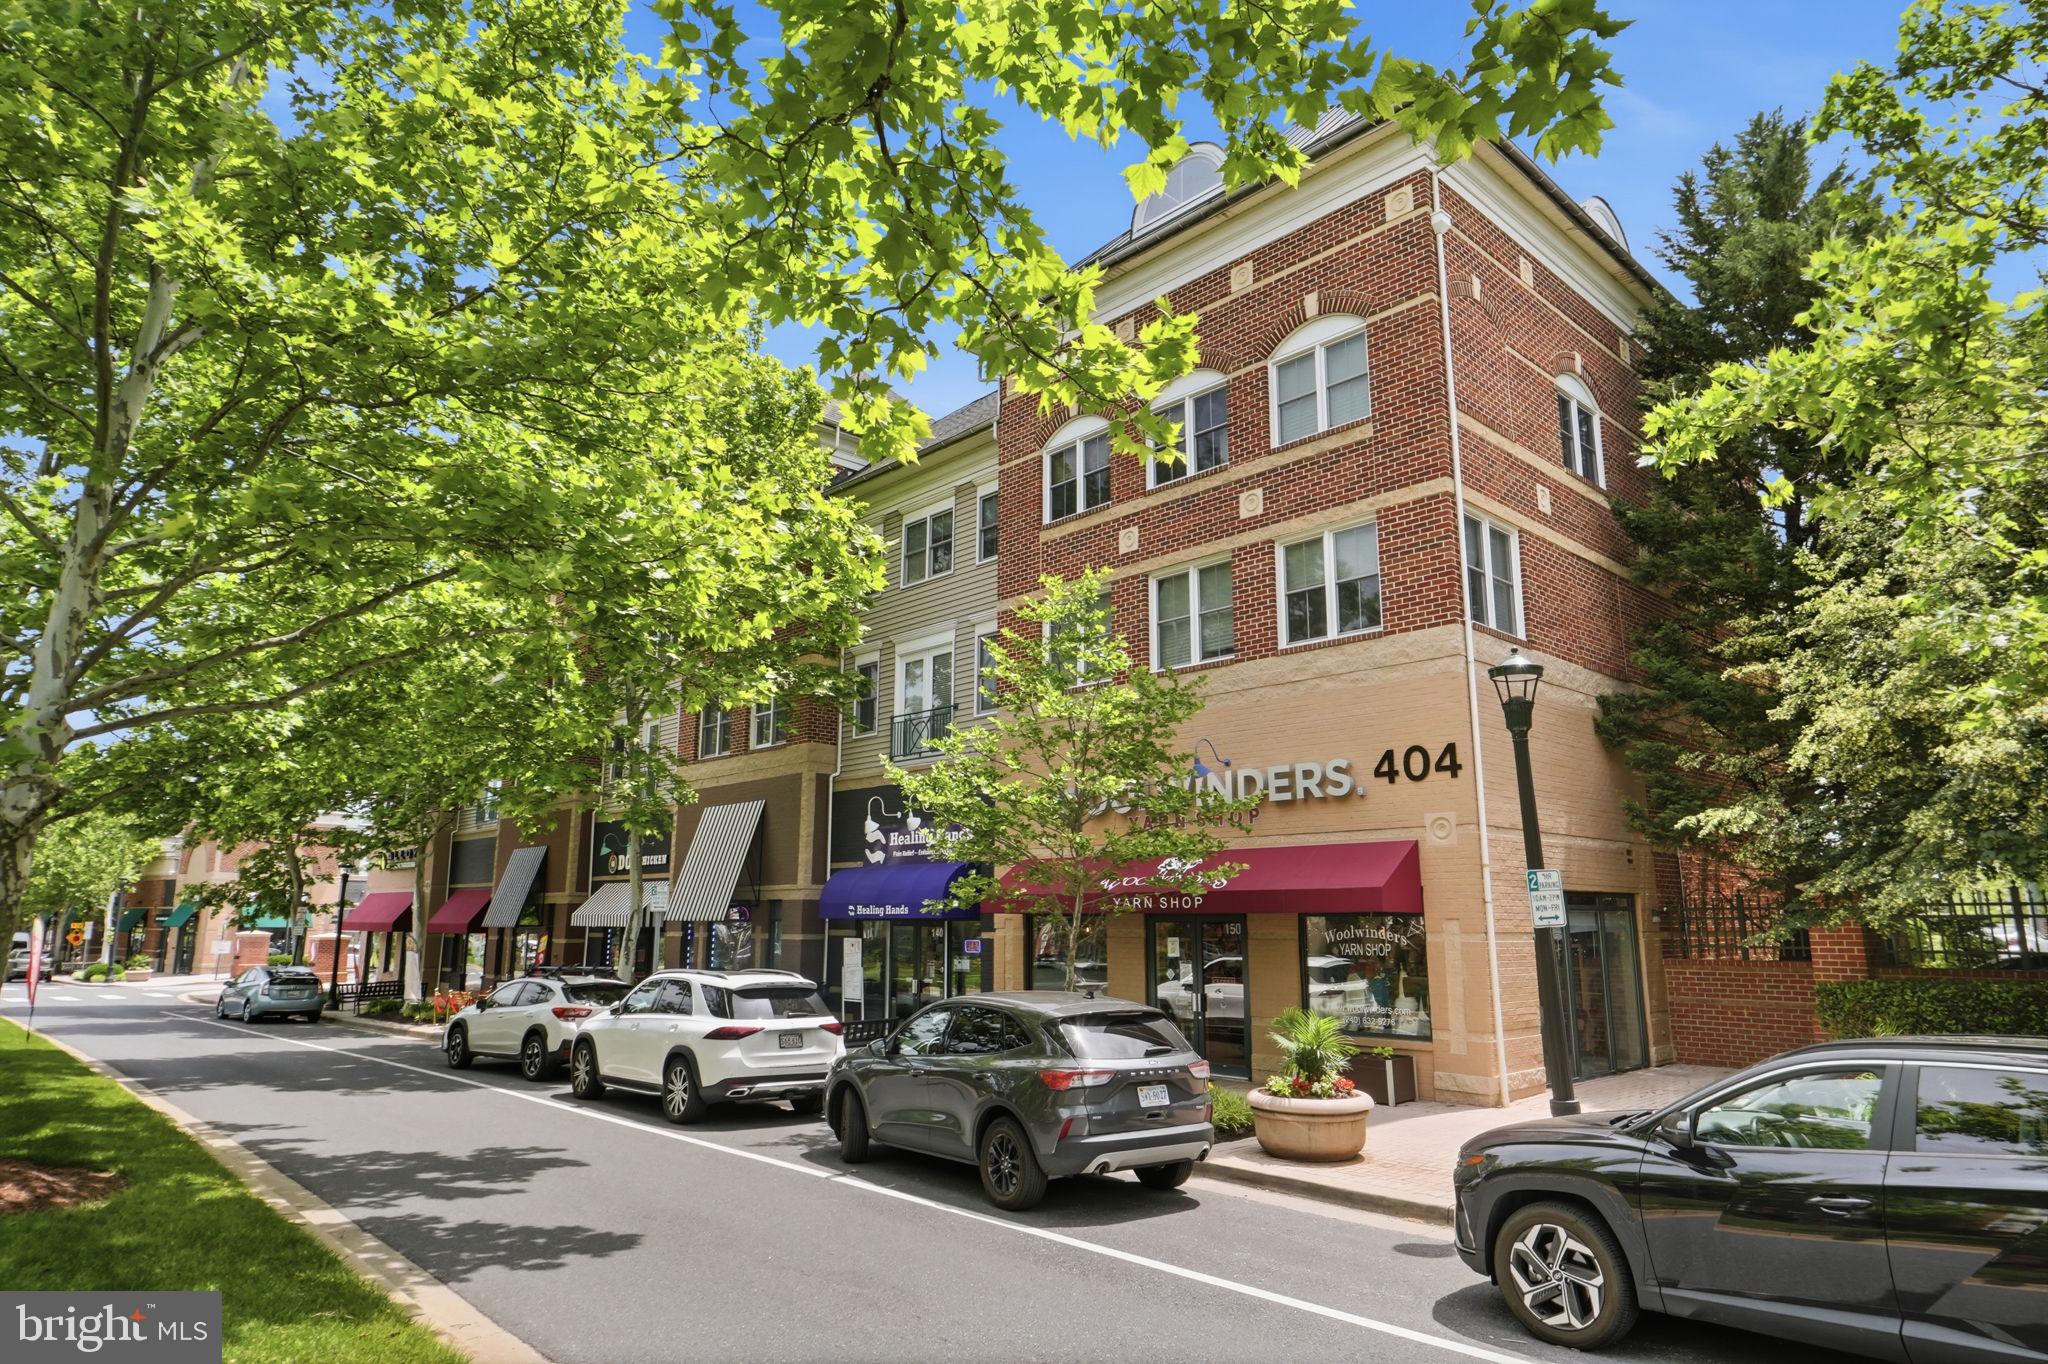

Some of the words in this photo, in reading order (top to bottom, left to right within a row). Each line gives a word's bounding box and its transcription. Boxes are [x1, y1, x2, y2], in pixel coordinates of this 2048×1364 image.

[1373, 742, 1462, 784] 404
[1529, 874, 1537, 889] 2
[1113, 897, 1152, 908] YARN
[1160, 896, 1203, 908] SHOP
[857, 905, 884, 916] Healing
[885, 904, 909, 914] Hands
[931, 927, 944, 938] 140
[1224, 923, 1242, 935] 150
[1324, 924, 1408, 946] Woolwinders
[1339, 943, 1363, 956] YARN
[1365, 943, 1392, 957] SHOP
